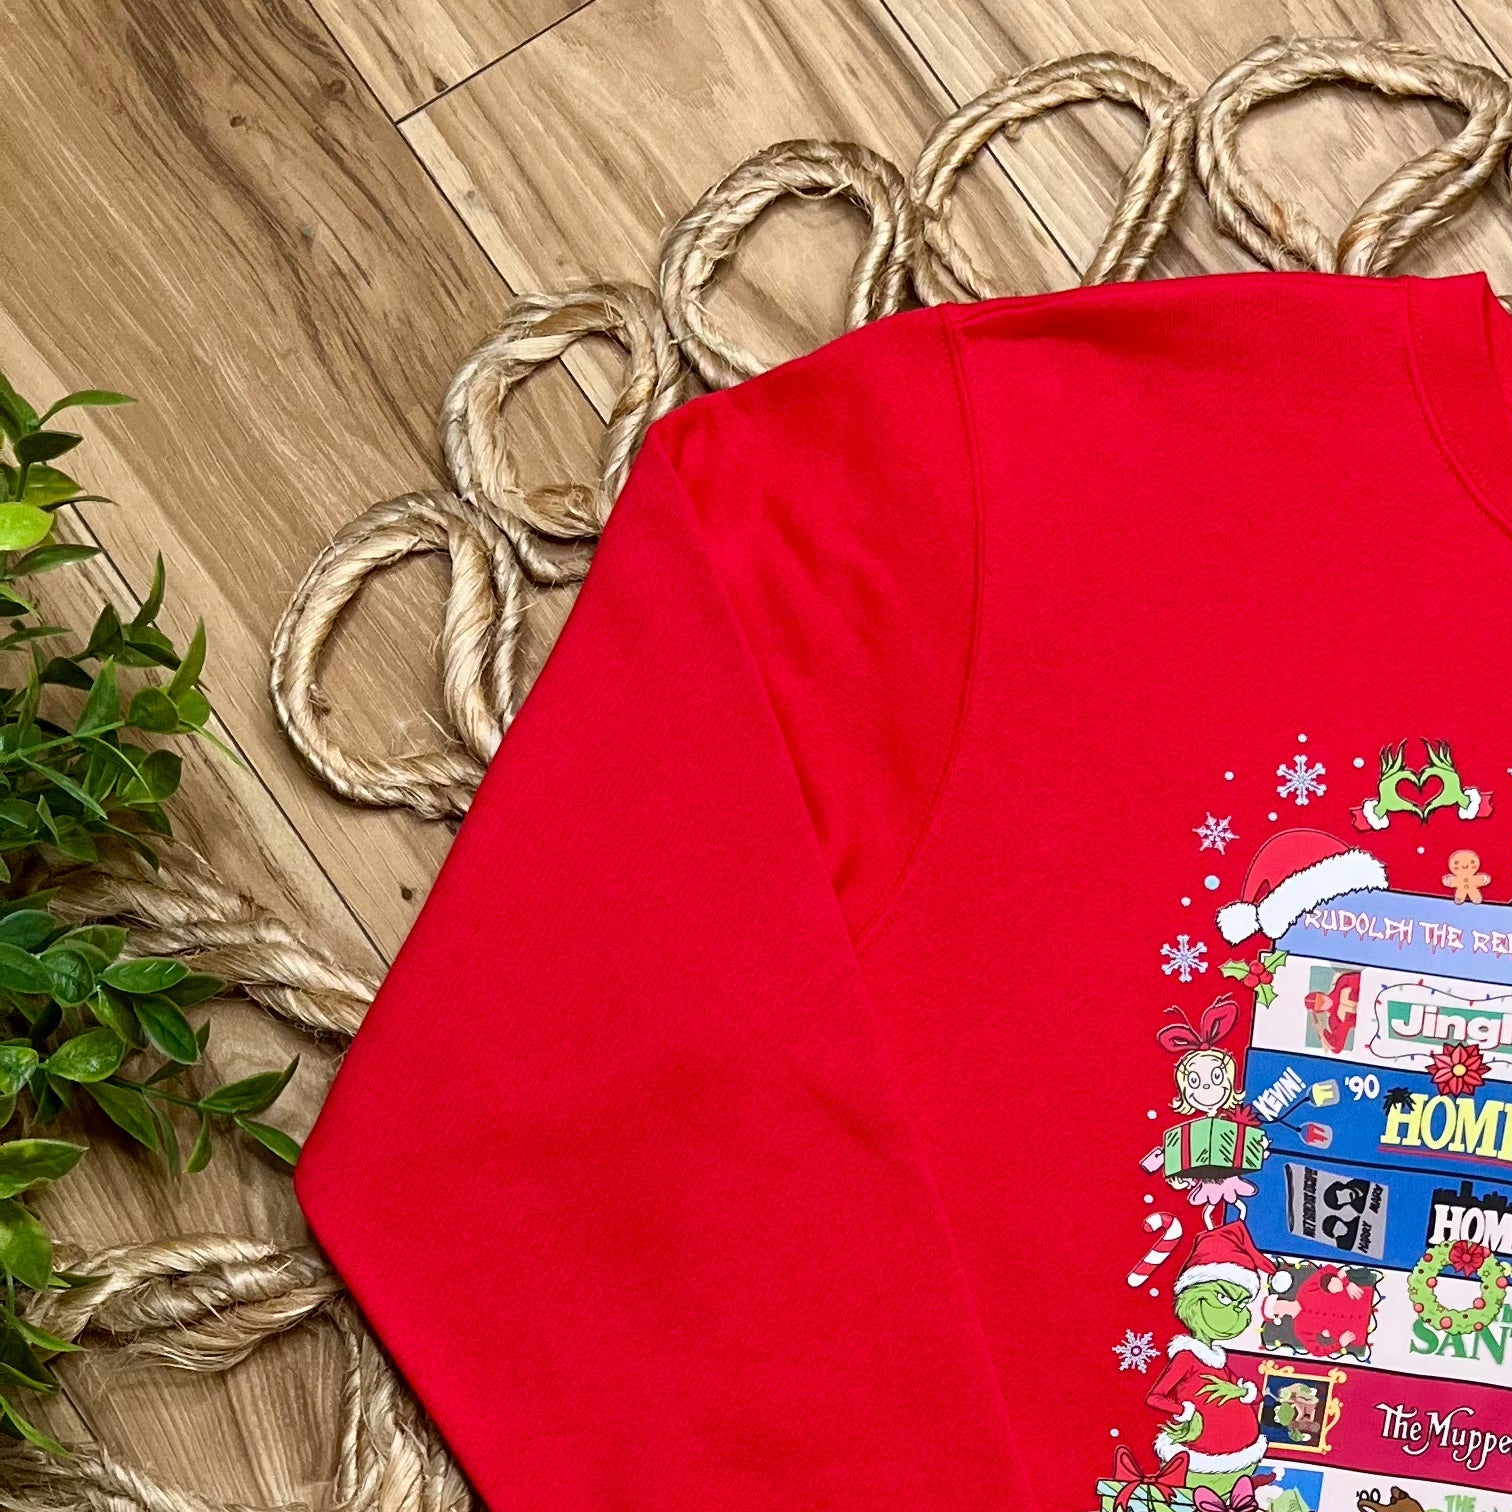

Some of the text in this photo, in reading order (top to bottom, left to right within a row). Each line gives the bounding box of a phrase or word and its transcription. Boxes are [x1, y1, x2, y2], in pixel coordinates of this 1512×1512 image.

[1304, 908, 1414, 950] RUDOLPH
[1418, 920, 1464, 953] THE
[1252, 1066, 1307, 1122] KEVIN!
[1344, 1073, 1380, 1101] '90
[1375, 1403, 1422, 1441] The
